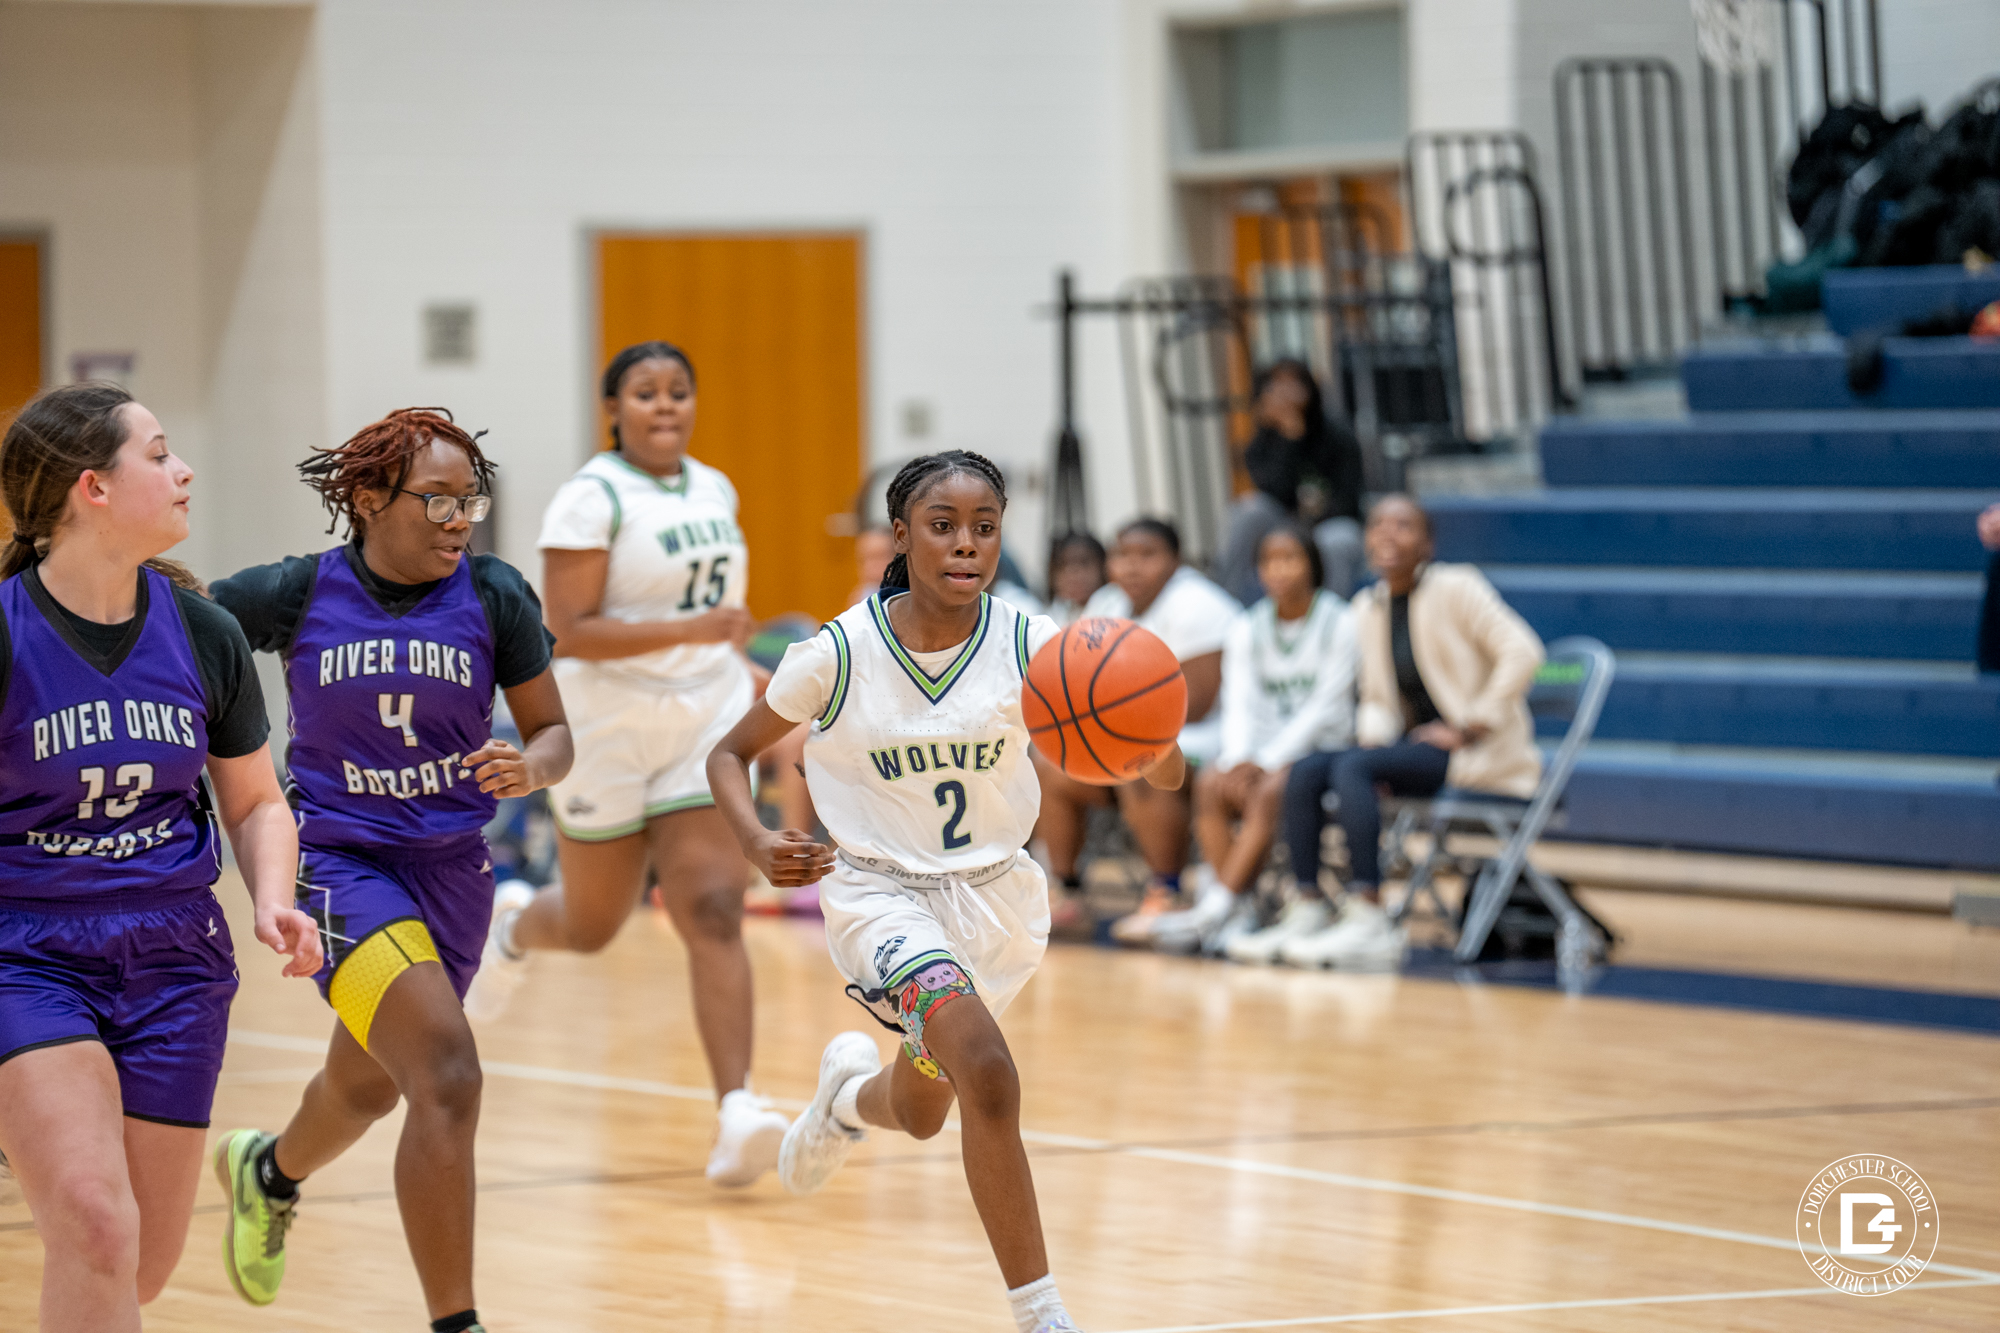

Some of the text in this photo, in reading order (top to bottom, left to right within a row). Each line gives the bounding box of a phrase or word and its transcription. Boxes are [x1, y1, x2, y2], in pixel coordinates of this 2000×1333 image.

[676, 555, 730, 610] 15
[320, 638, 472, 688] RIVER OAKS
[33, 699, 197, 761] RIVER OAKS
[377, 693, 419, 747] 4
[867, 736, 1006, 782] WOLVES
[77, 762, 154, 819] 13
[933, 779, 973, 851] 2
